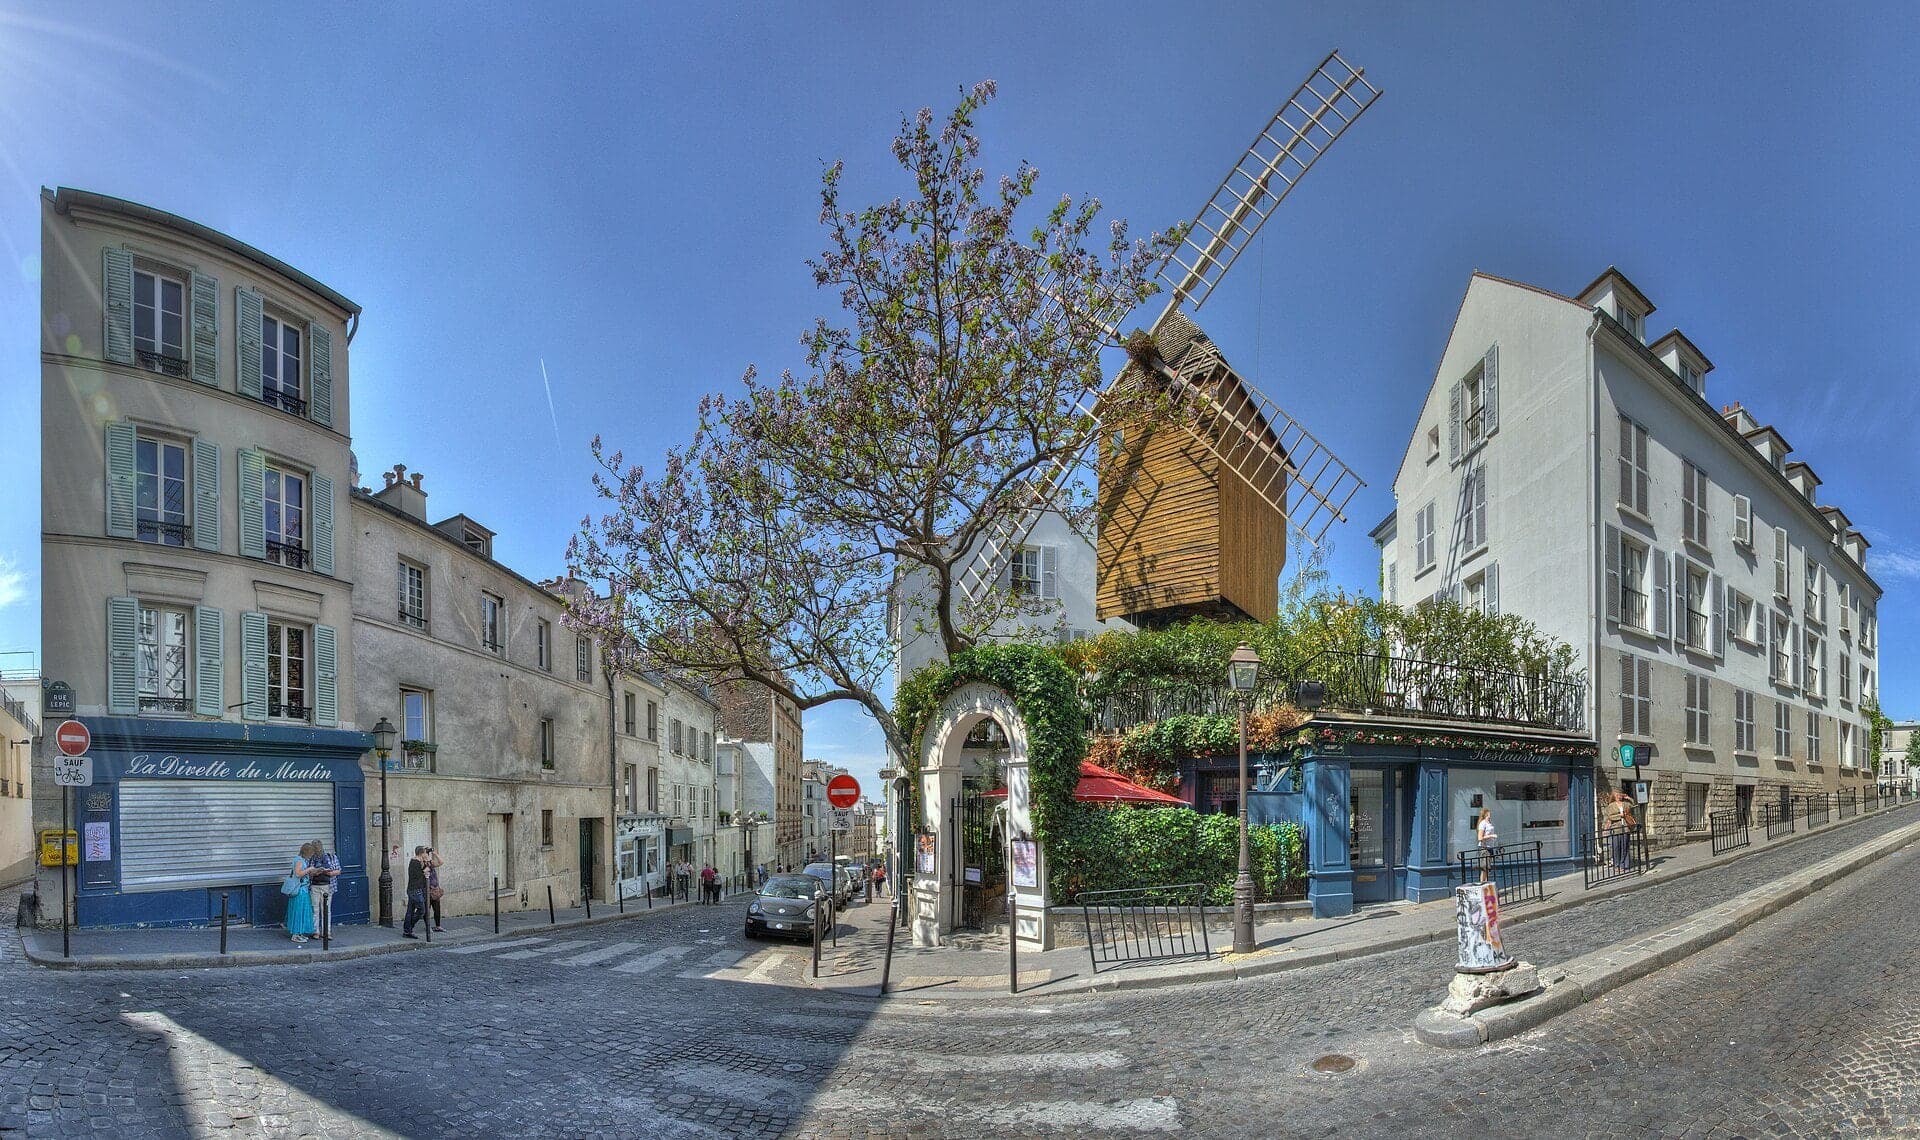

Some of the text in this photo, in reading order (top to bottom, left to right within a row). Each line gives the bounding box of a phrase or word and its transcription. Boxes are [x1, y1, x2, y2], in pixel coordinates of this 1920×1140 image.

[64, 758, 84, 767] SAUF
[125, 754, 333, 780] La Divette du Moulin
